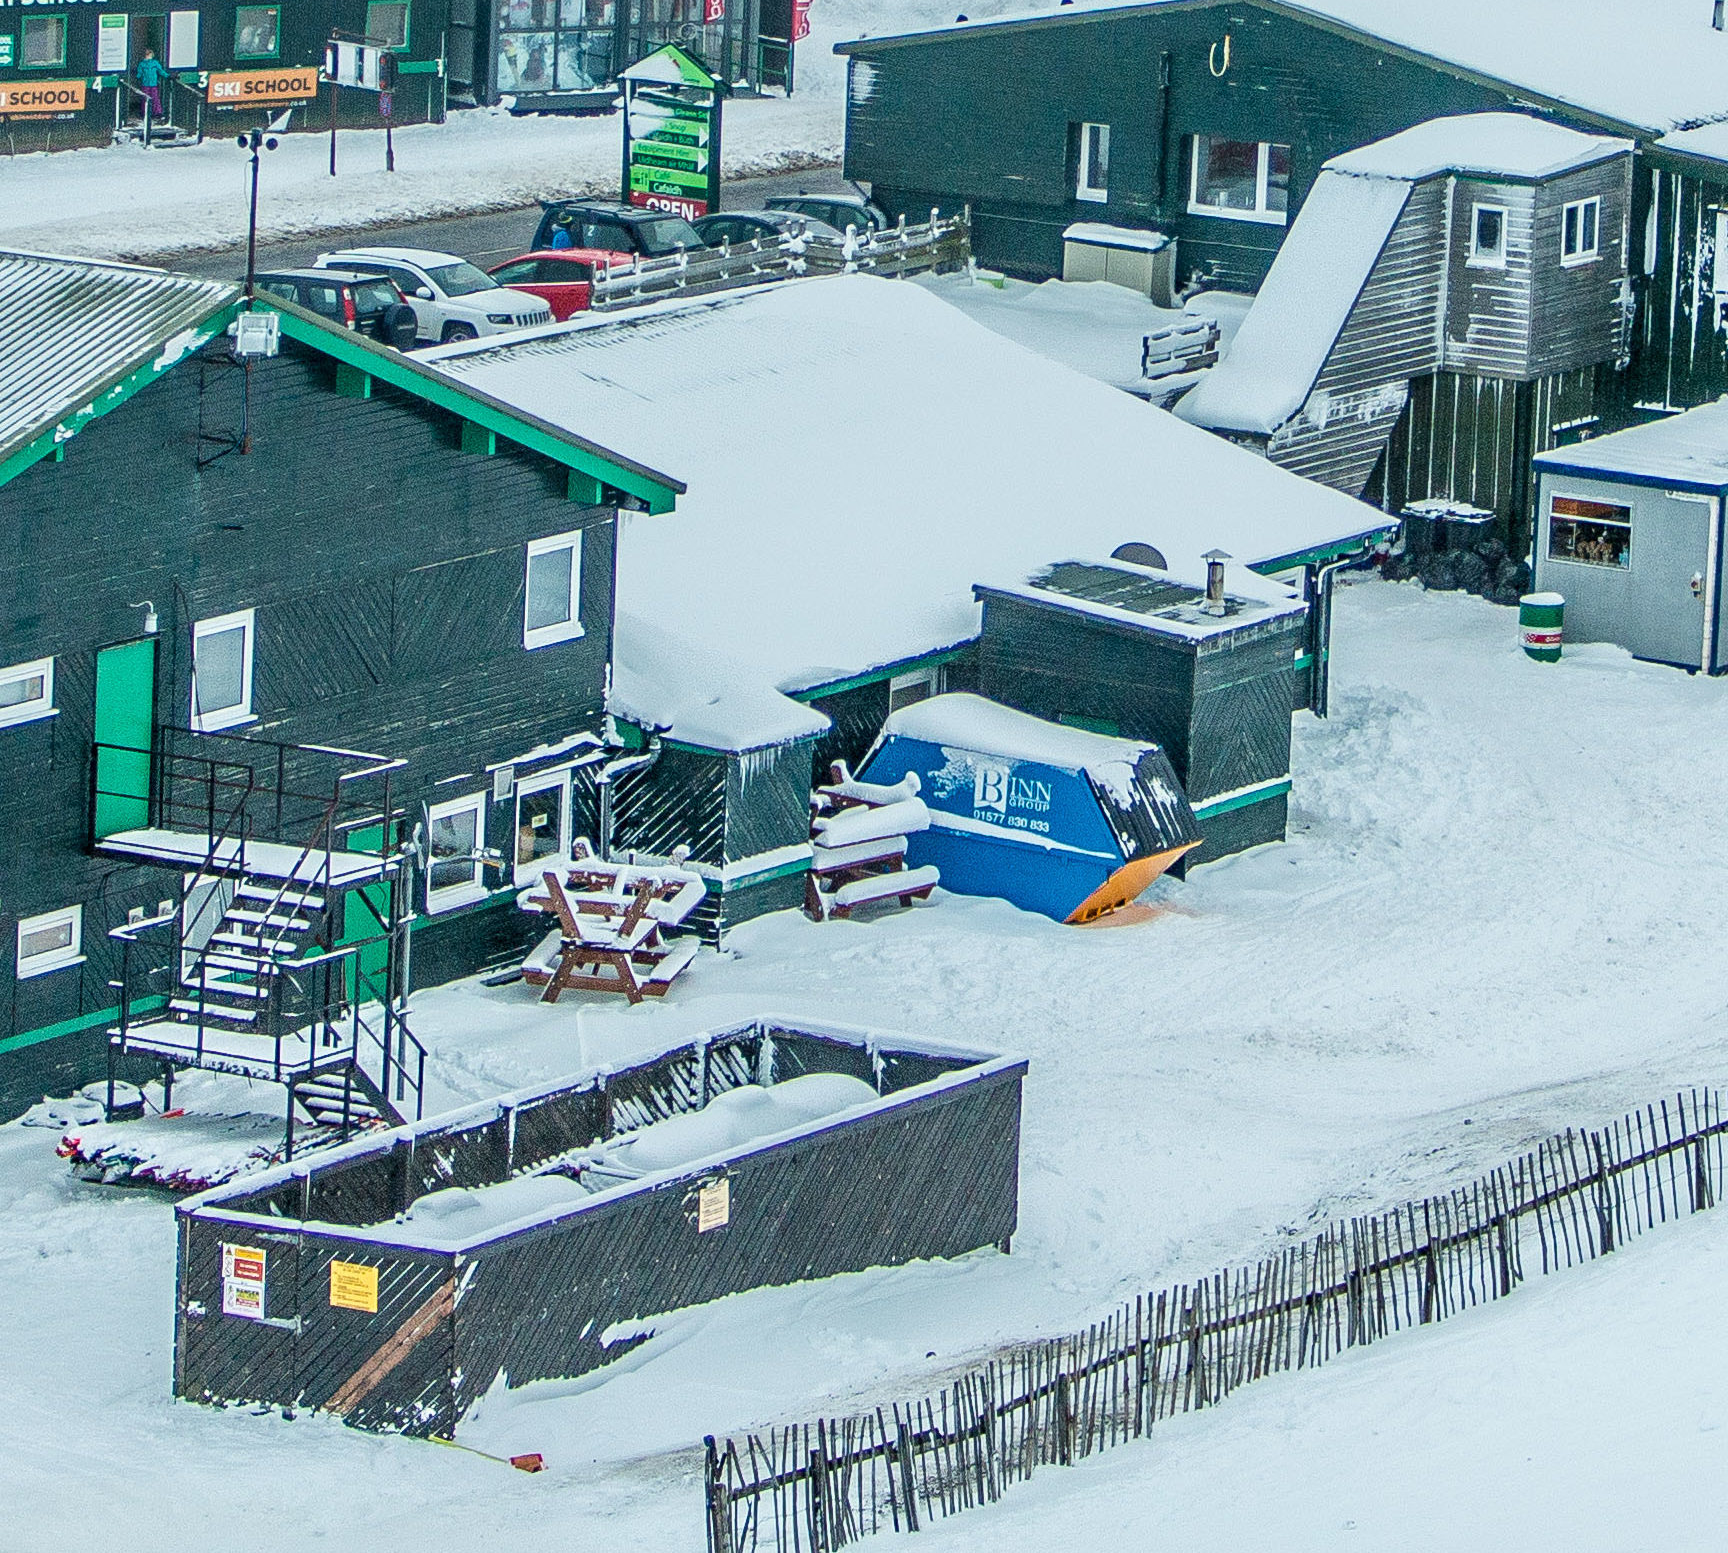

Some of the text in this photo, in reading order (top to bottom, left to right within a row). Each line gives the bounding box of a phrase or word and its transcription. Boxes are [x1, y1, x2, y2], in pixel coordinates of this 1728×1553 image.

[91, 76, 103, 94] 4
[197, 70, 209, 89] 3
[213, 77, 312, 98] SKI SCHOOL
[9, 90, 80, 106] SCHOOL
[645, 197, 695, 222] OPEN
[1008, 797, 1051, 813] GROUP
[973, 808, 1050, 833] 01577 830 833
